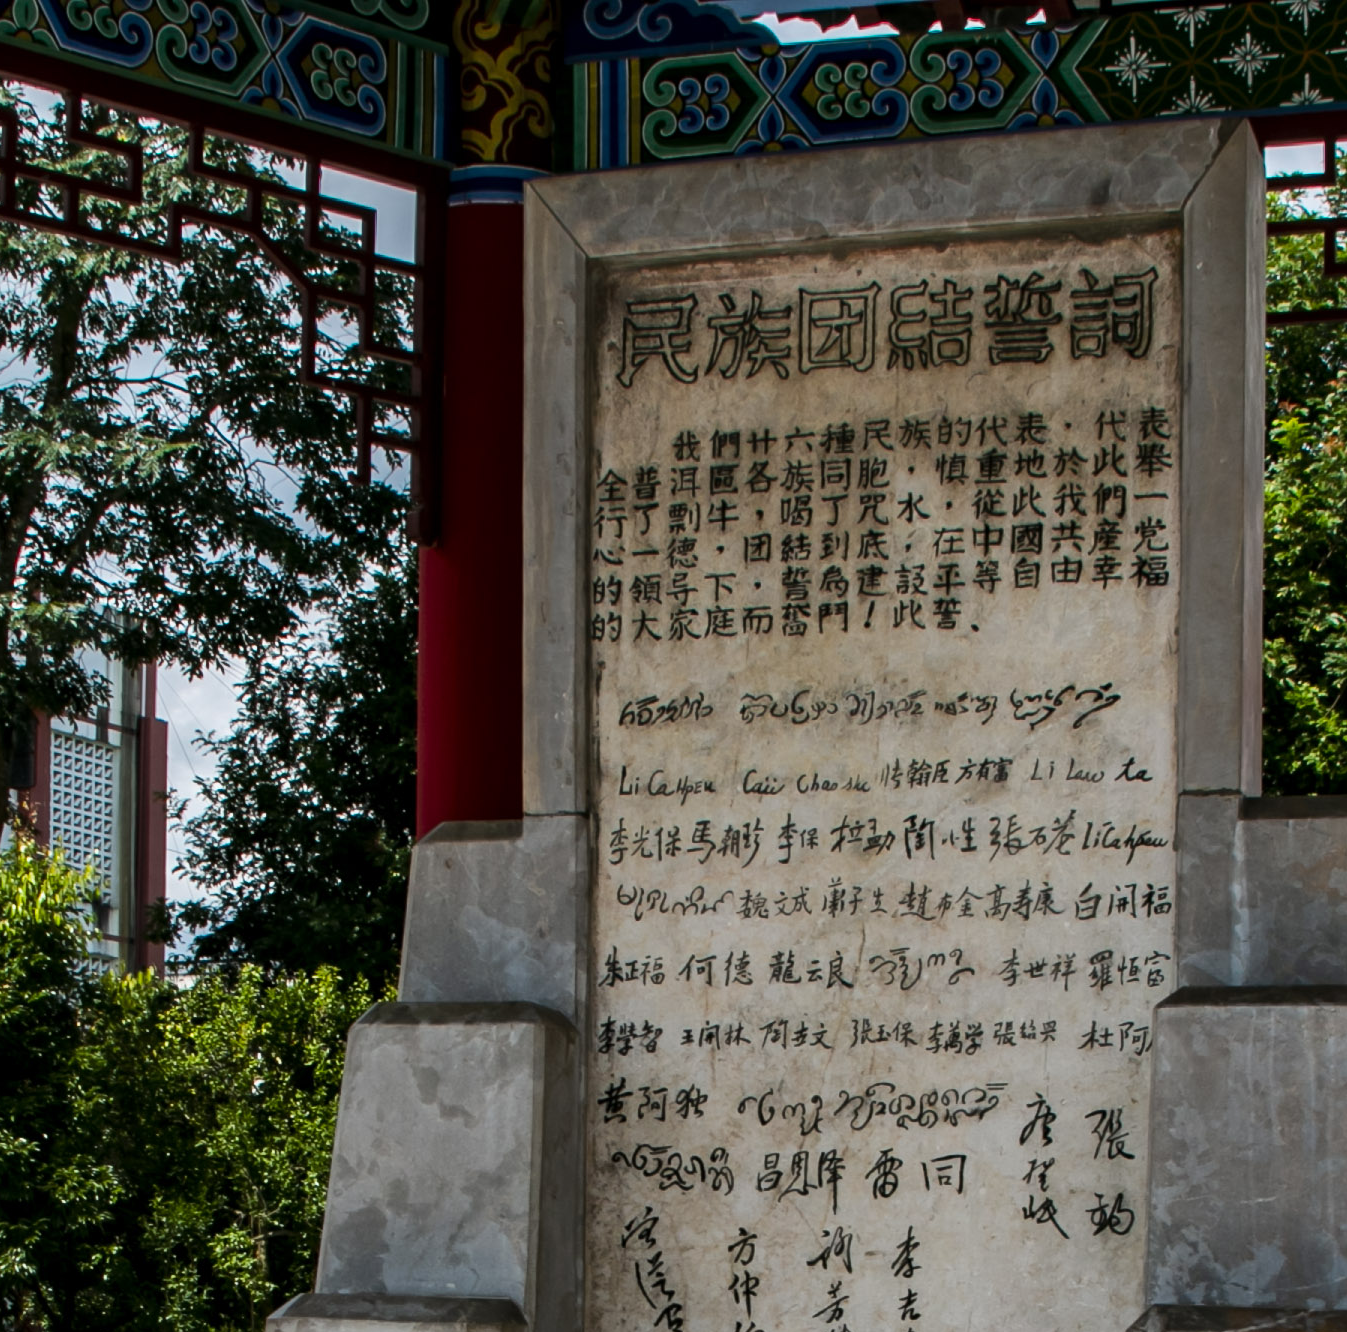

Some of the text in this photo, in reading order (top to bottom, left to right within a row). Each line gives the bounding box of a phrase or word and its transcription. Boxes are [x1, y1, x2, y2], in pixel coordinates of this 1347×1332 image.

[778, 812, 819, 865] 李保
[598, 945, 666, 988] 朱正福
[1077, 1019, 1153, 1057] 杜阿
